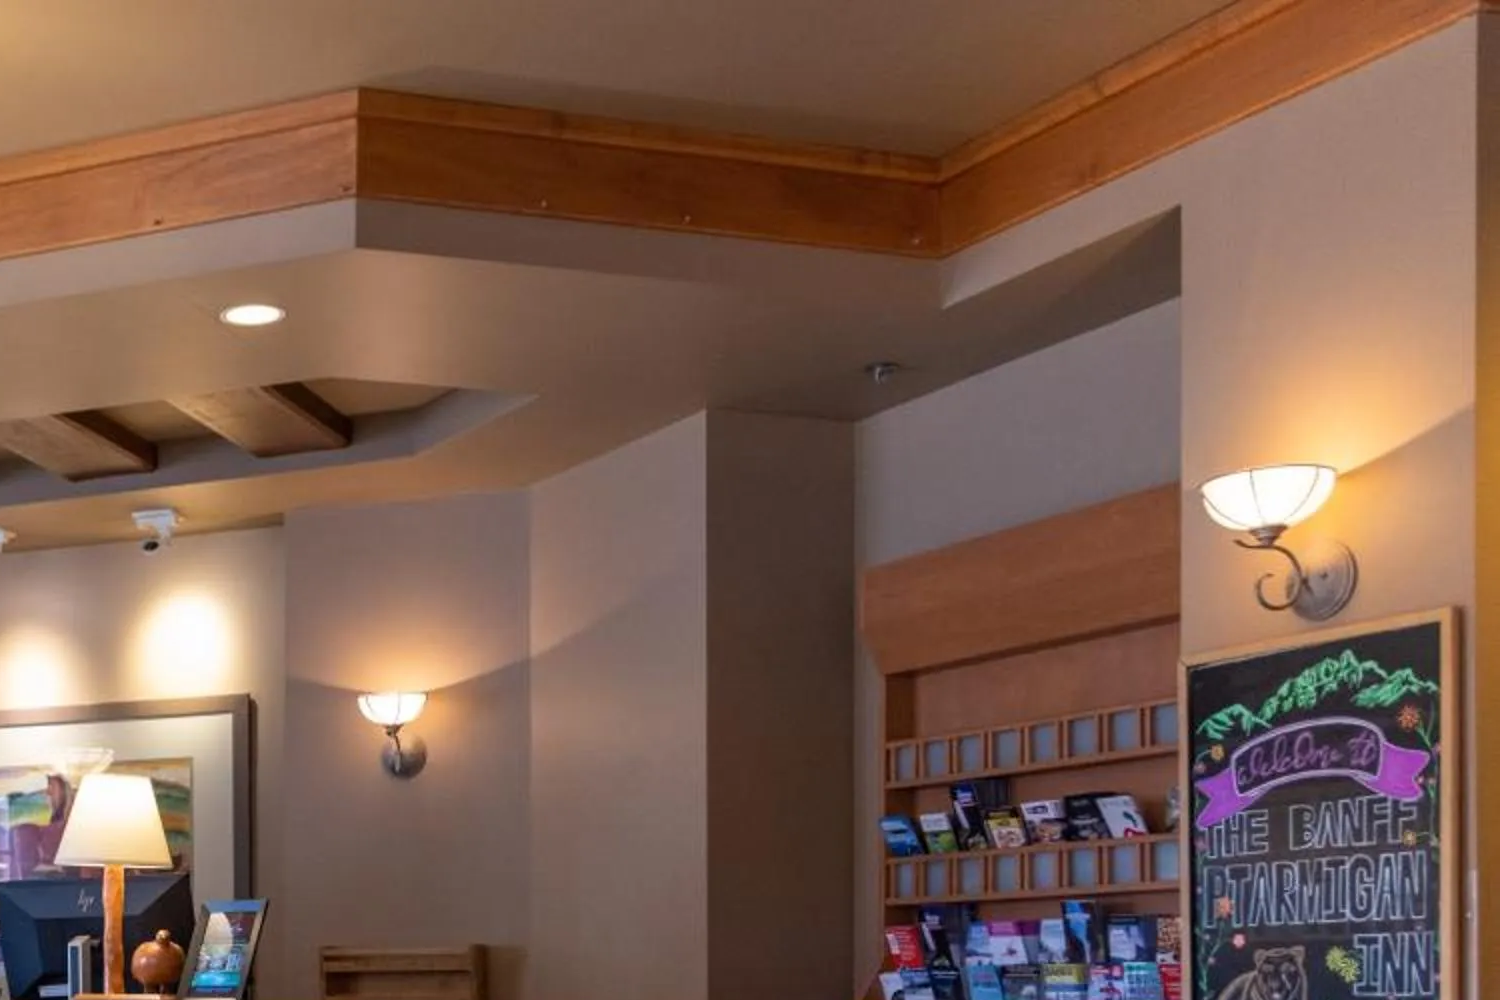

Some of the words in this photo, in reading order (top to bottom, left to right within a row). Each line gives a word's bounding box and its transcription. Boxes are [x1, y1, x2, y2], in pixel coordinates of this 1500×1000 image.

[1204, 808, 1269, 859] THE
[1288, 796, 1418, 851] BANFF
[1203, 850, 1430, 930] PTARMIGAN
[1353, 929, 1435, 998] INN
